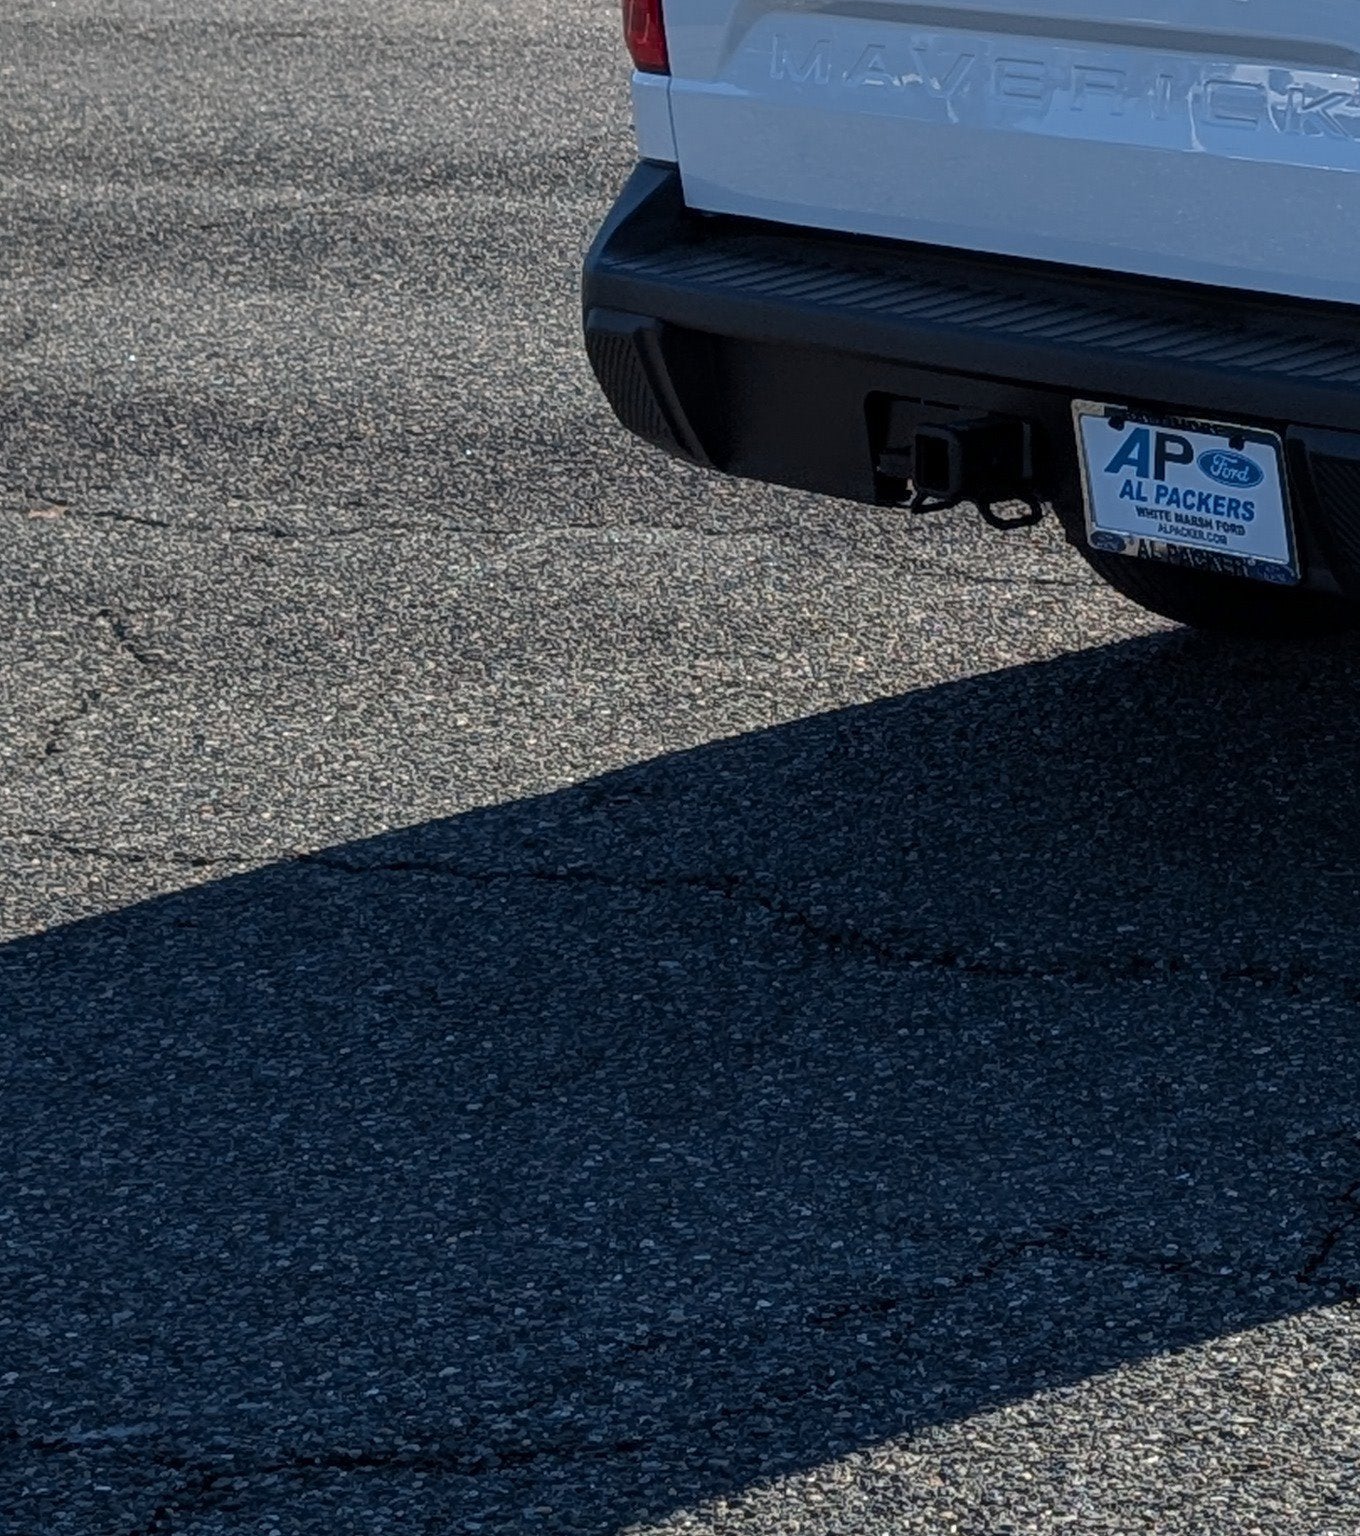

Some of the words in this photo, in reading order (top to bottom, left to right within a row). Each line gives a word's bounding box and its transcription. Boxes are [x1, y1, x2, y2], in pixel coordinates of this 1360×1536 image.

[769, 33, 1358, 140] MAVERICK
[1104, 427, 1194, 481] AP
[1119, 479, 1148, 502] AL
[1154, 484, 1255, 522] PACKERS
[1136, 506, 1172, 522] WHITE
[1174, 512, 1213, 530] MARSH
[1215, 519, 1246, 536] FORD
